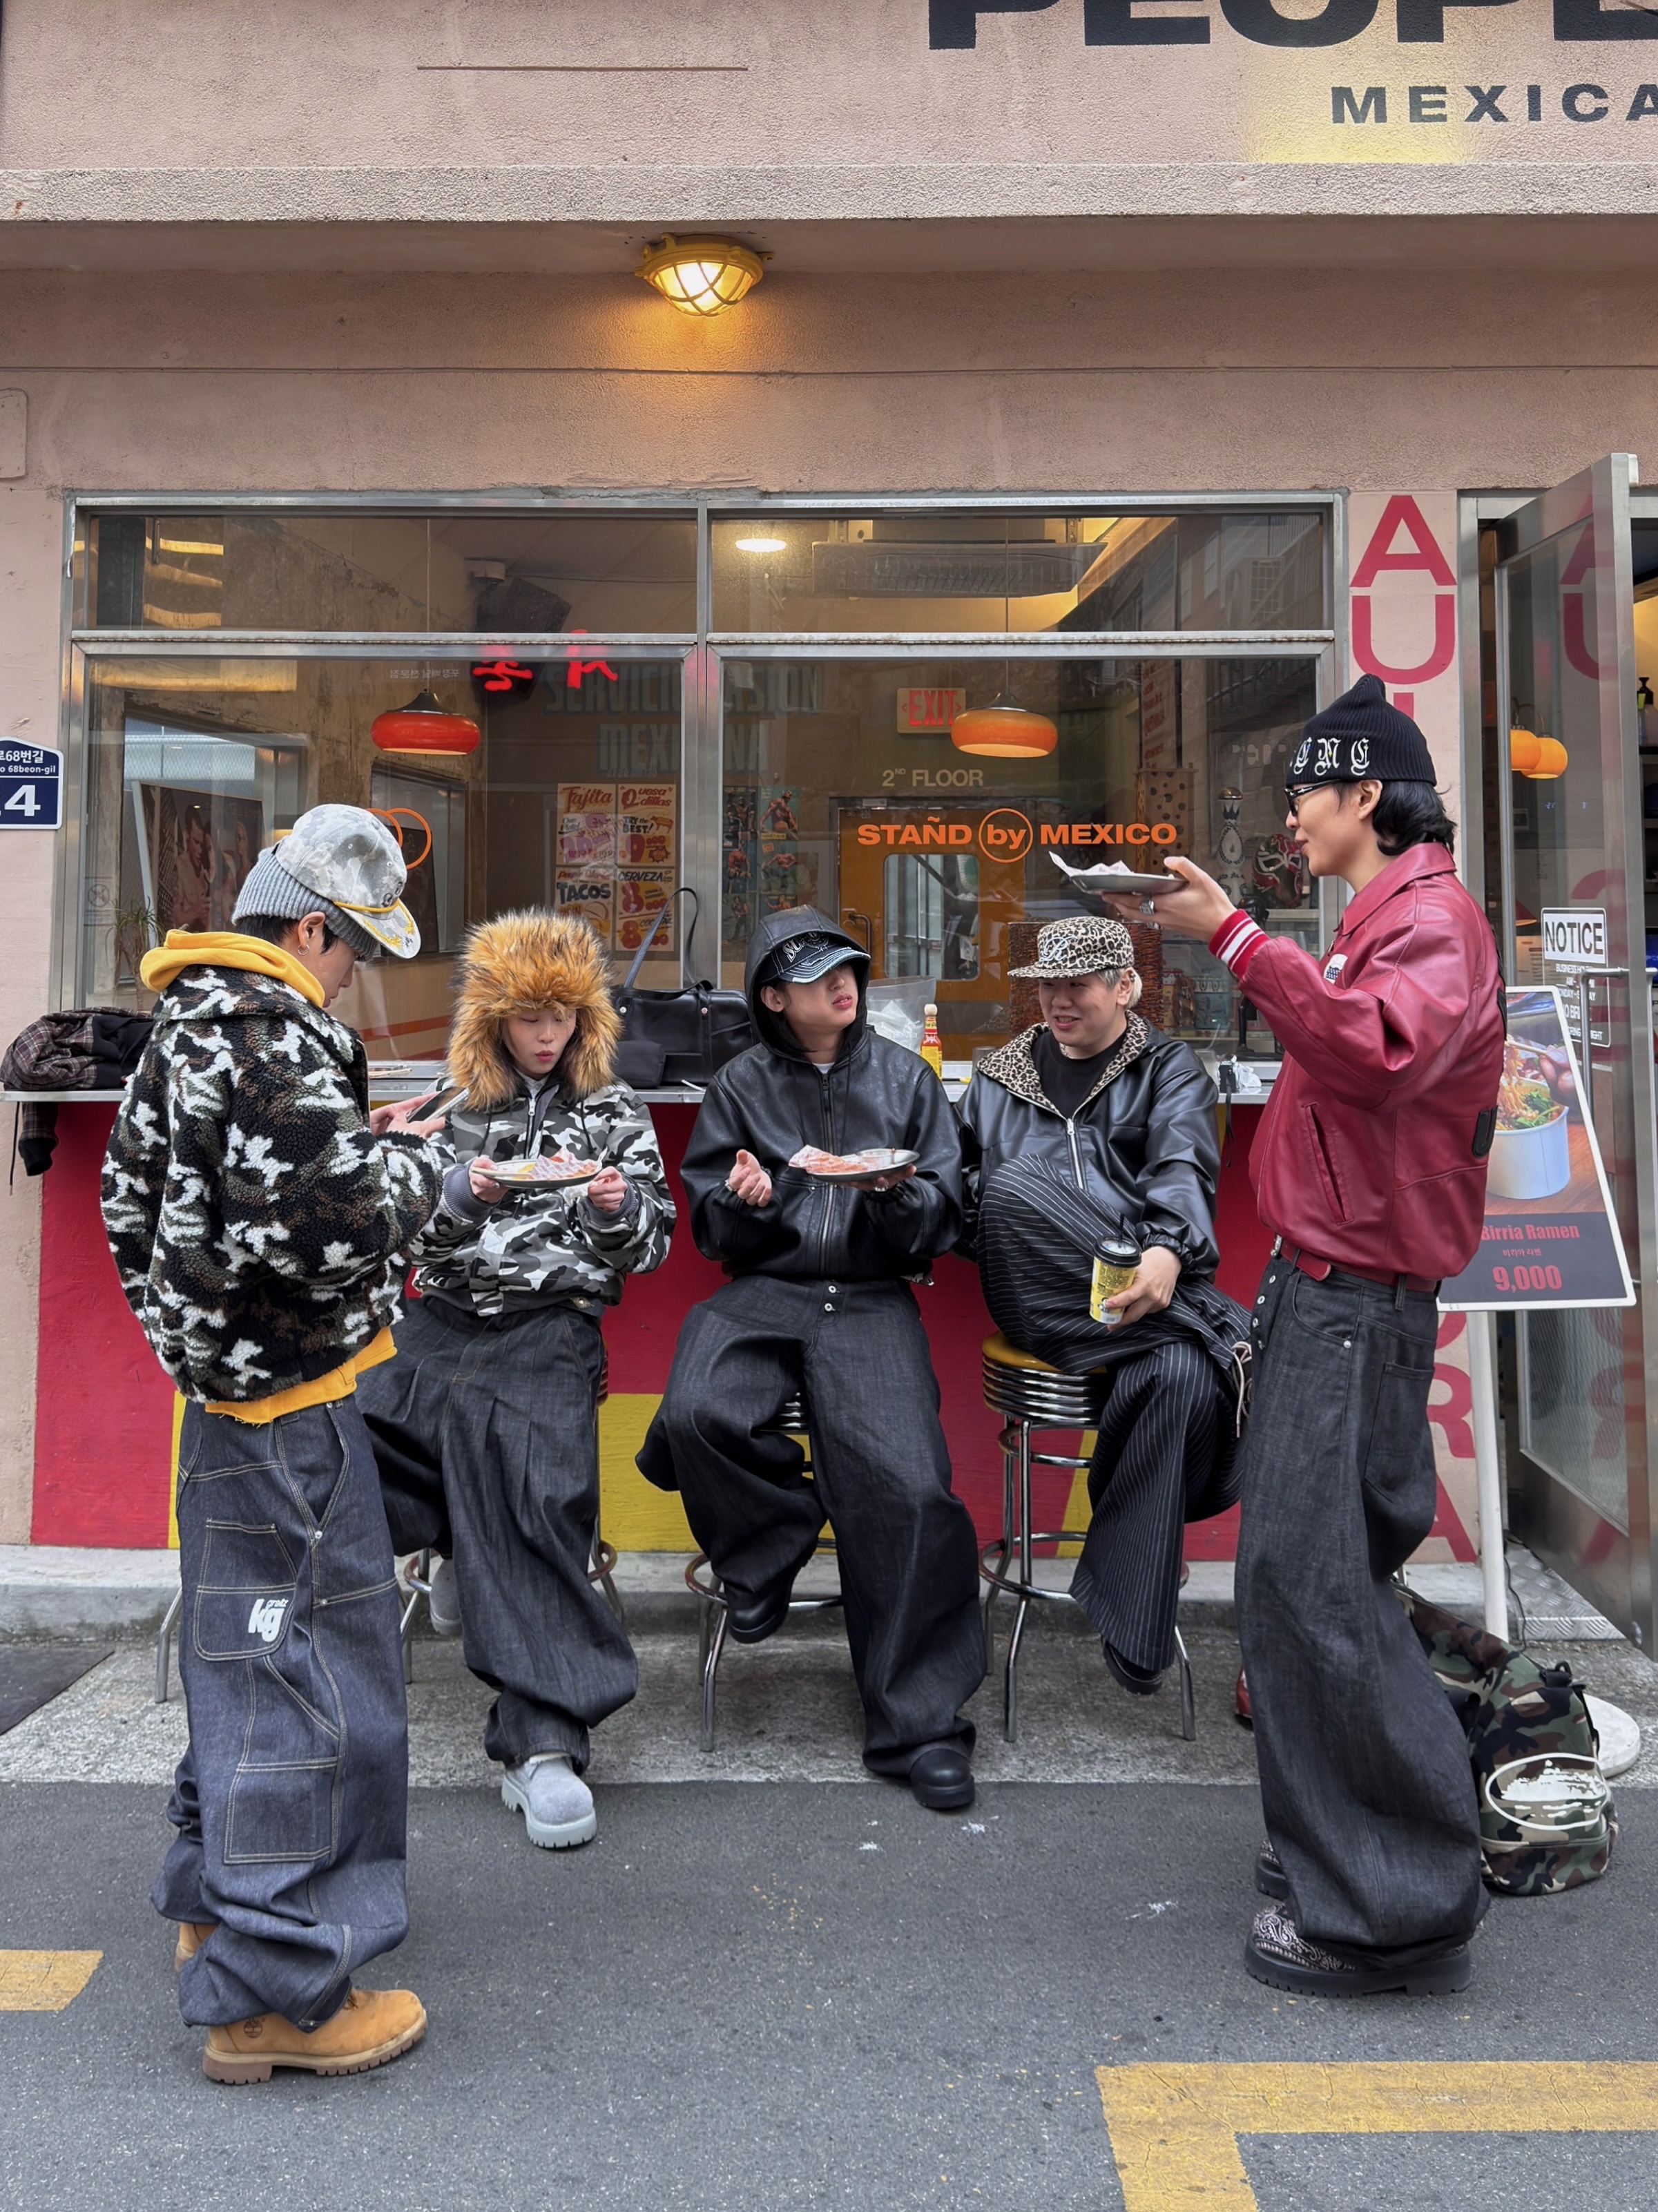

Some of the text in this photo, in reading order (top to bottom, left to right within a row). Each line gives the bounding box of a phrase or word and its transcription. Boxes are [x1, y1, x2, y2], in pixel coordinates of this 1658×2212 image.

[909, 690, 958, 727] EXIT
[8, 765, 56, 775] 68beon-gil
[912, 769, 984, 787] FLOOR
[0, 785, 41, 816] 4
[562, 786, 613, 813] Fajita
[858, 816, 1177, 850] STAÑD by MEXICO
[618, 872, 664, 882] CERVEZA
[557, 882, 611, 905] TACOS
[1545, 921, 1604, 955] NOTICE
[1556, 963, 1577, 974] BUSINESS
[1525, 1224, 1581, 1240] Ramen
[1492, 1264, 1563, 1293] 9,000
